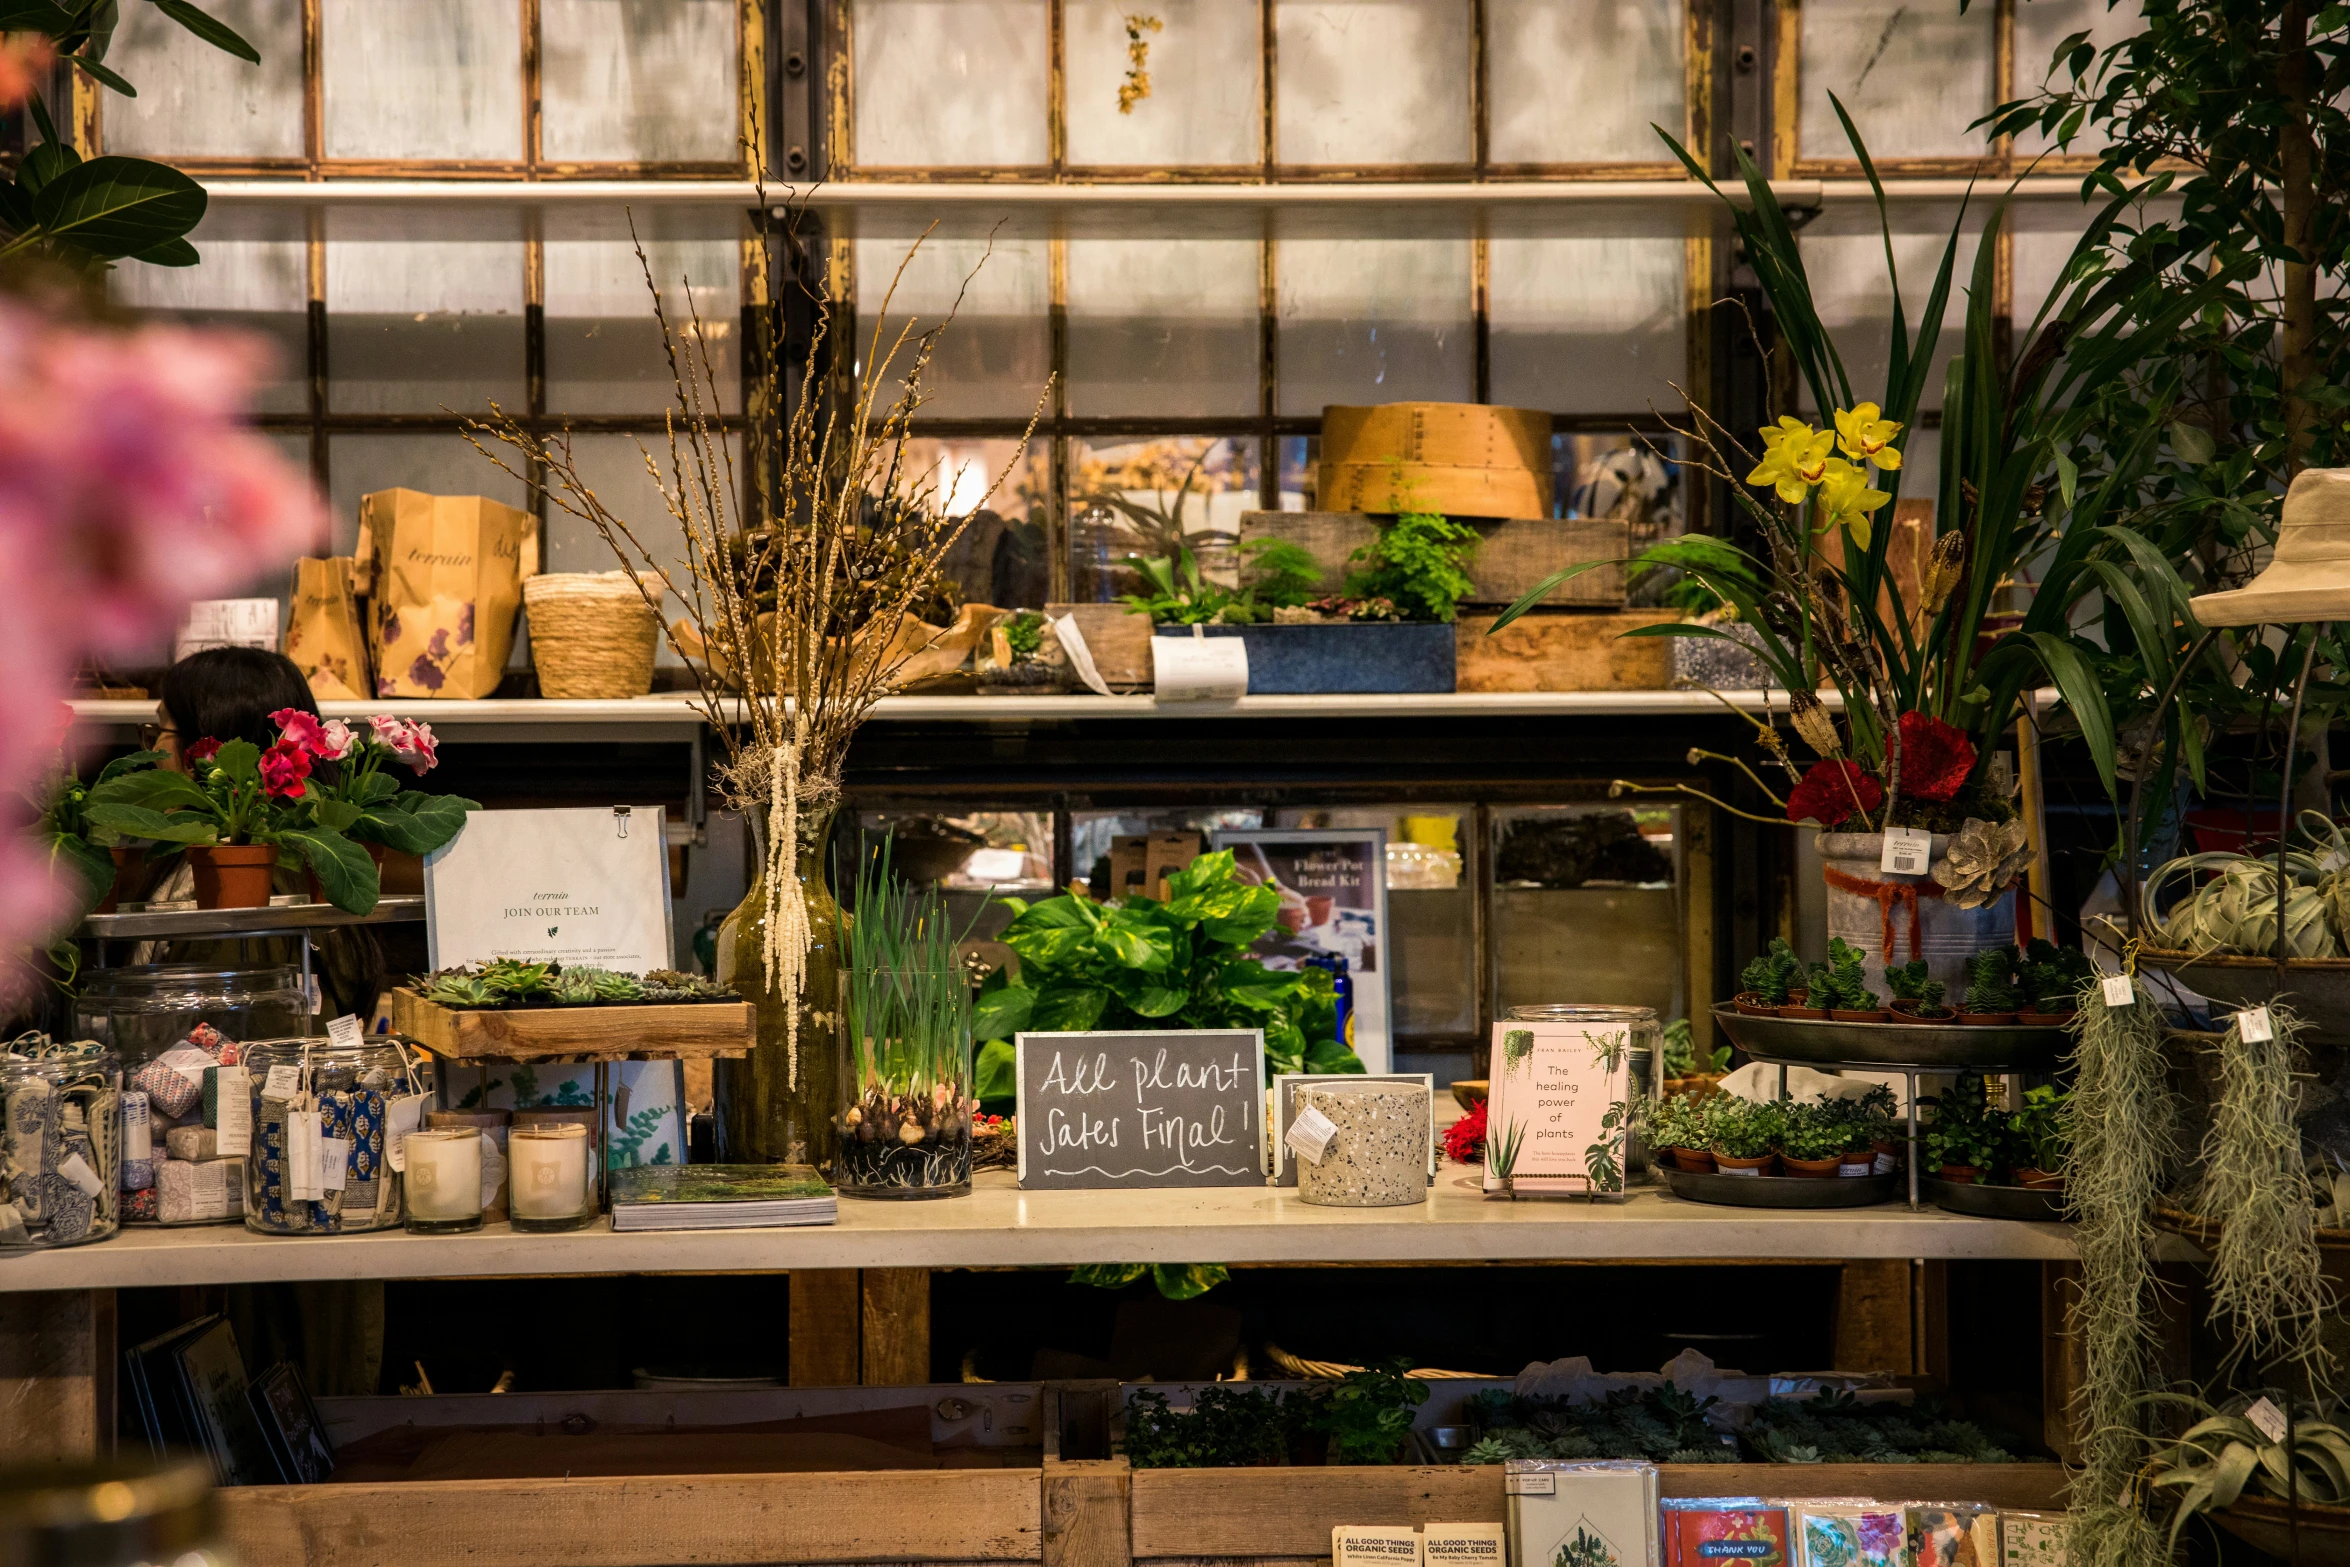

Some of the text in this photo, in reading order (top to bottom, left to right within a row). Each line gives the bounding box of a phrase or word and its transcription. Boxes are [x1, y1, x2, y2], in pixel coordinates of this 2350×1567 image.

[407, 547, 473, 568] terrain
[1293, 858, 1364, 872] Flower Pot
[1298, 874, 1361, 887] Bread Kit
[533, 891, 569, 900] terrain
[504, 906, 599, 919] JOIN OUR TEAM
[1040, 1052, 1116, 1094] All
[1130, 1047, 1250, 1104] plant
[1548, 1066, 1569, 1076] The
[1536, 1082, 1579, 1094] healing
[1538, 1099, 1575, 1108] power
[1549, 1113, 1562, 1122] of
[1040, 1108, 1120, 1156] Sales
[1536, 1128, 1574, 1140] plants
[1987, 1528, 1996, 1549] YEAR
[1708, 1546, 1766, 1554] THANK YOU
[1988, 1550, 1997, 1561] OF
